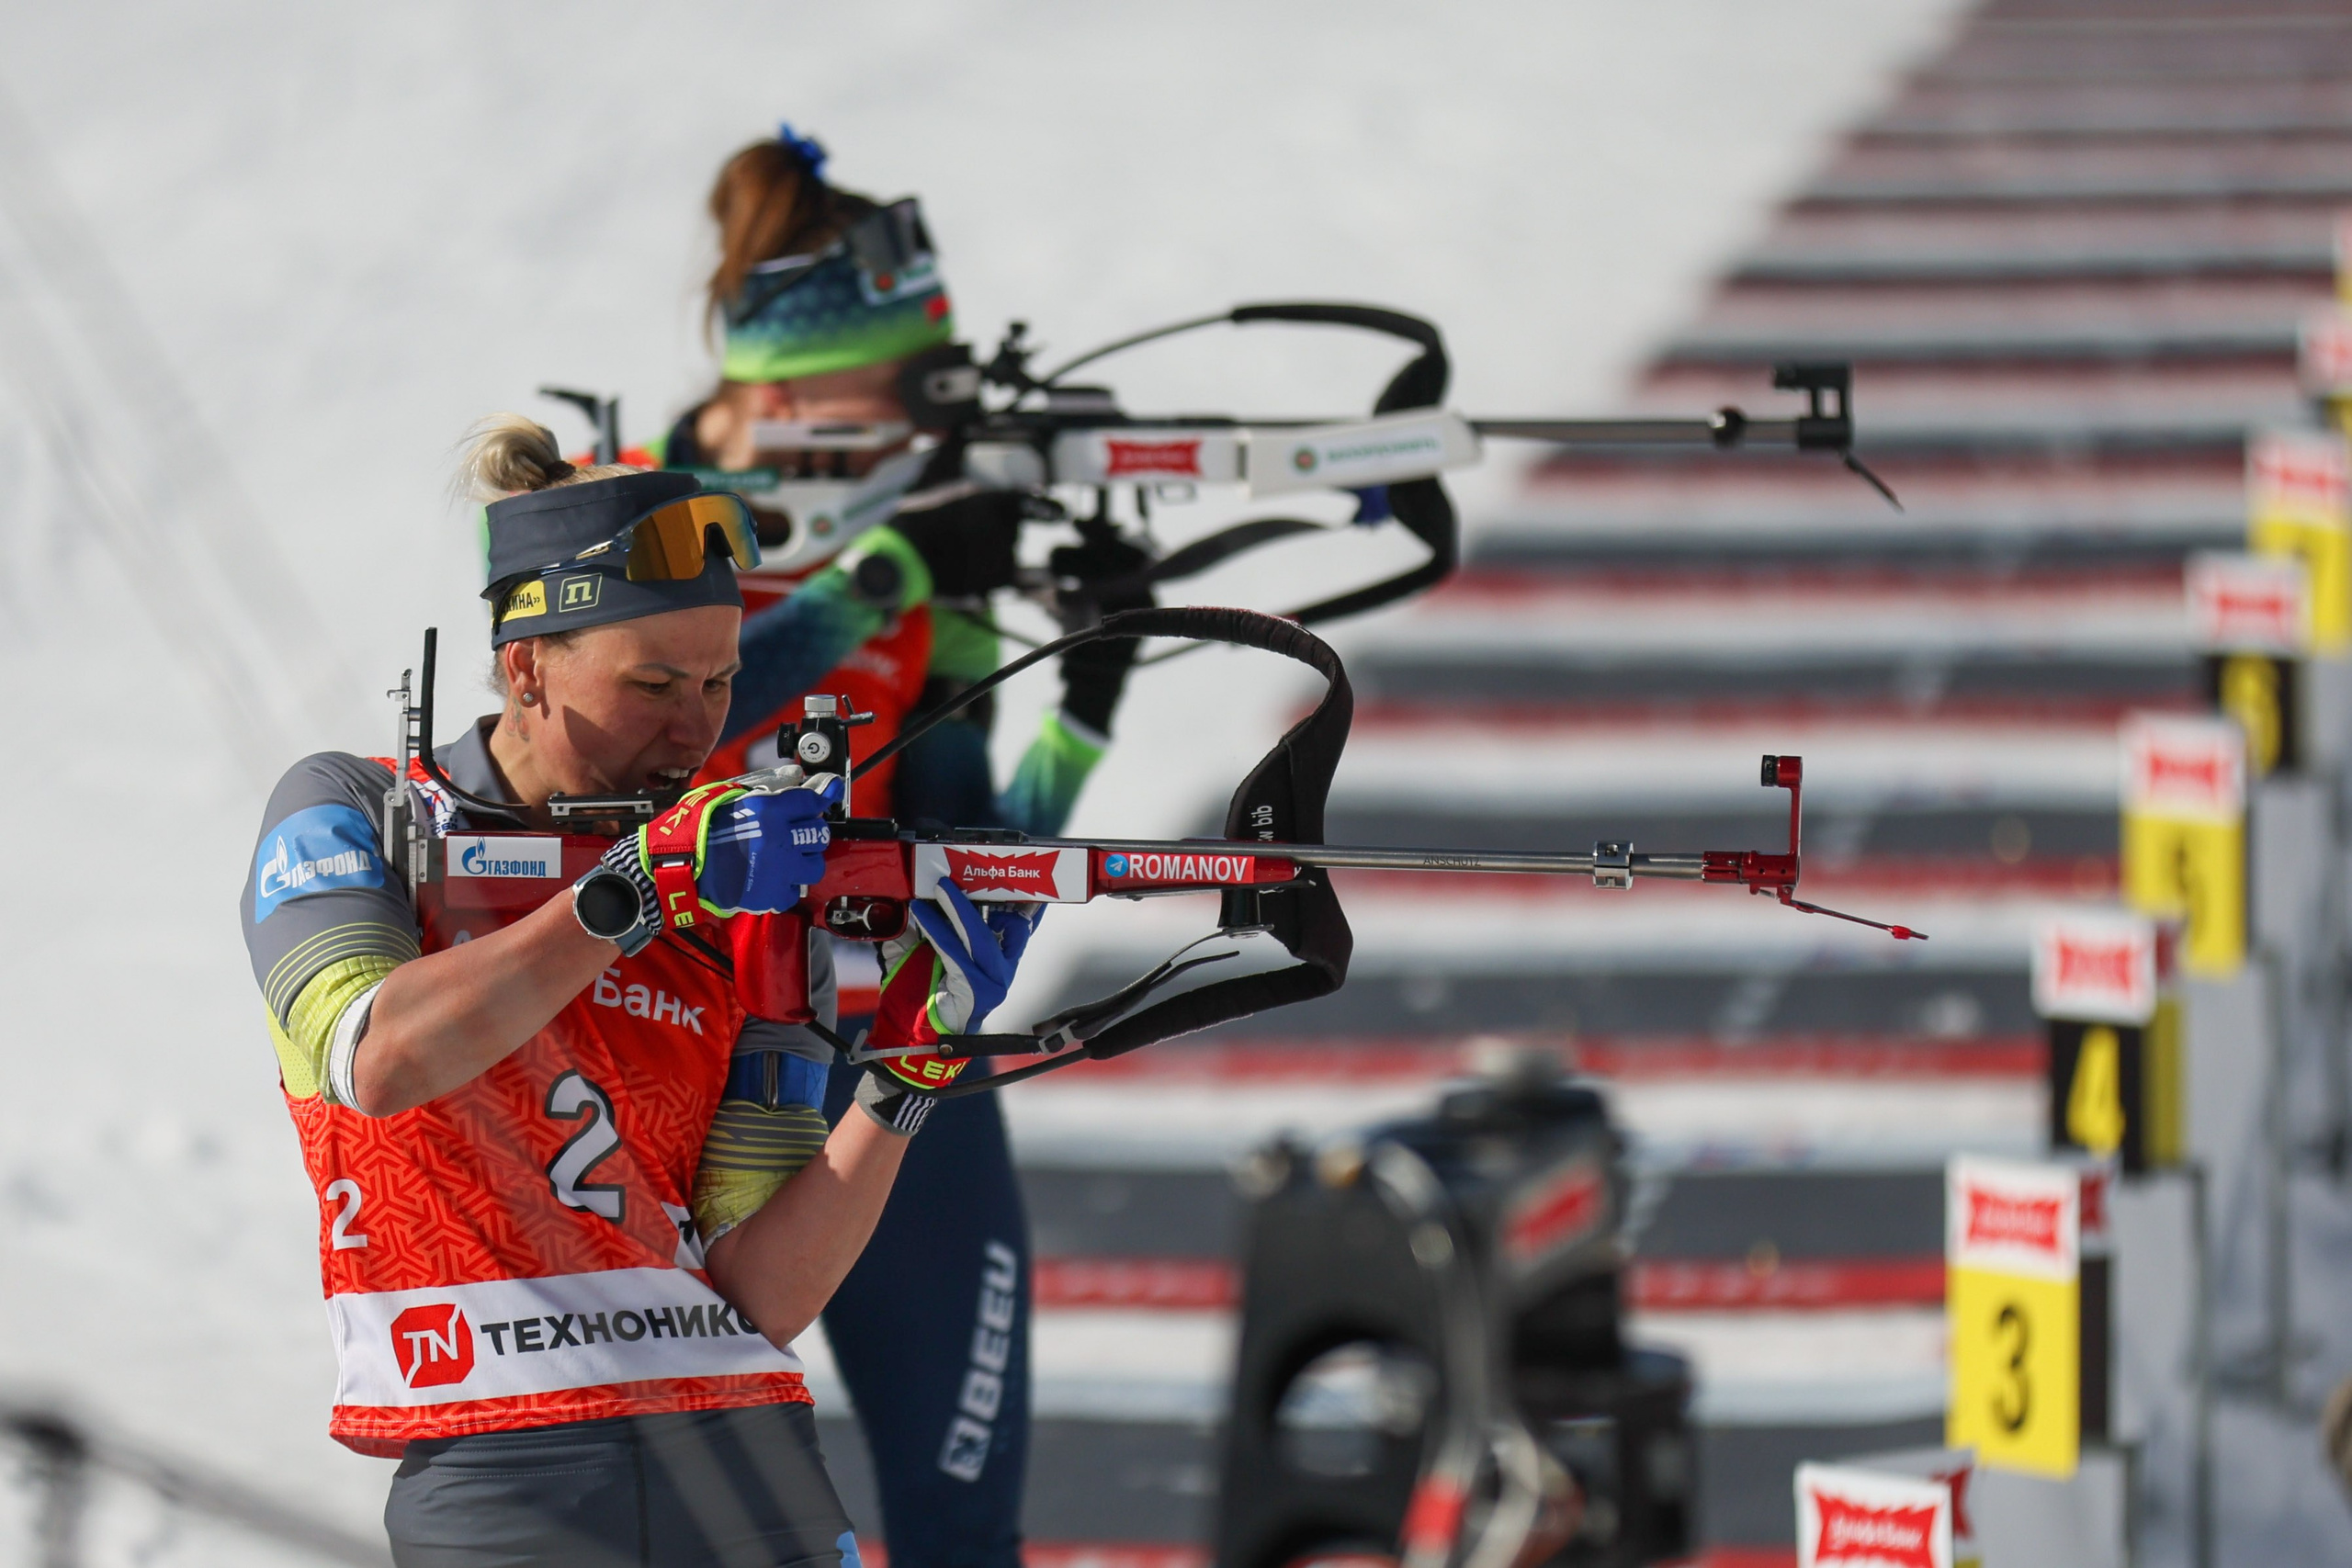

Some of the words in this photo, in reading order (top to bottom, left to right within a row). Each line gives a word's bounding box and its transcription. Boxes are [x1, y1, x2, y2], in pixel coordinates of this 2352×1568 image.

[291, 850, 372, 888] ГАЗФОНД
[487, 860, 547, 877] ГАЗФОНД
[963, 864, 1006, 880] Альфа
[1008, 865, 1041, 879] Банк
[1129, 854, 1249, 882] ROMANOV
[593, 966, 706, 1036] Банк
[2066, 1021, 2127, 1158] 4
[544, 1067, 626, 1224] 2
[326, 1179, 368, 1250] 2
[1991, 1296, 2033, 1441] 3
